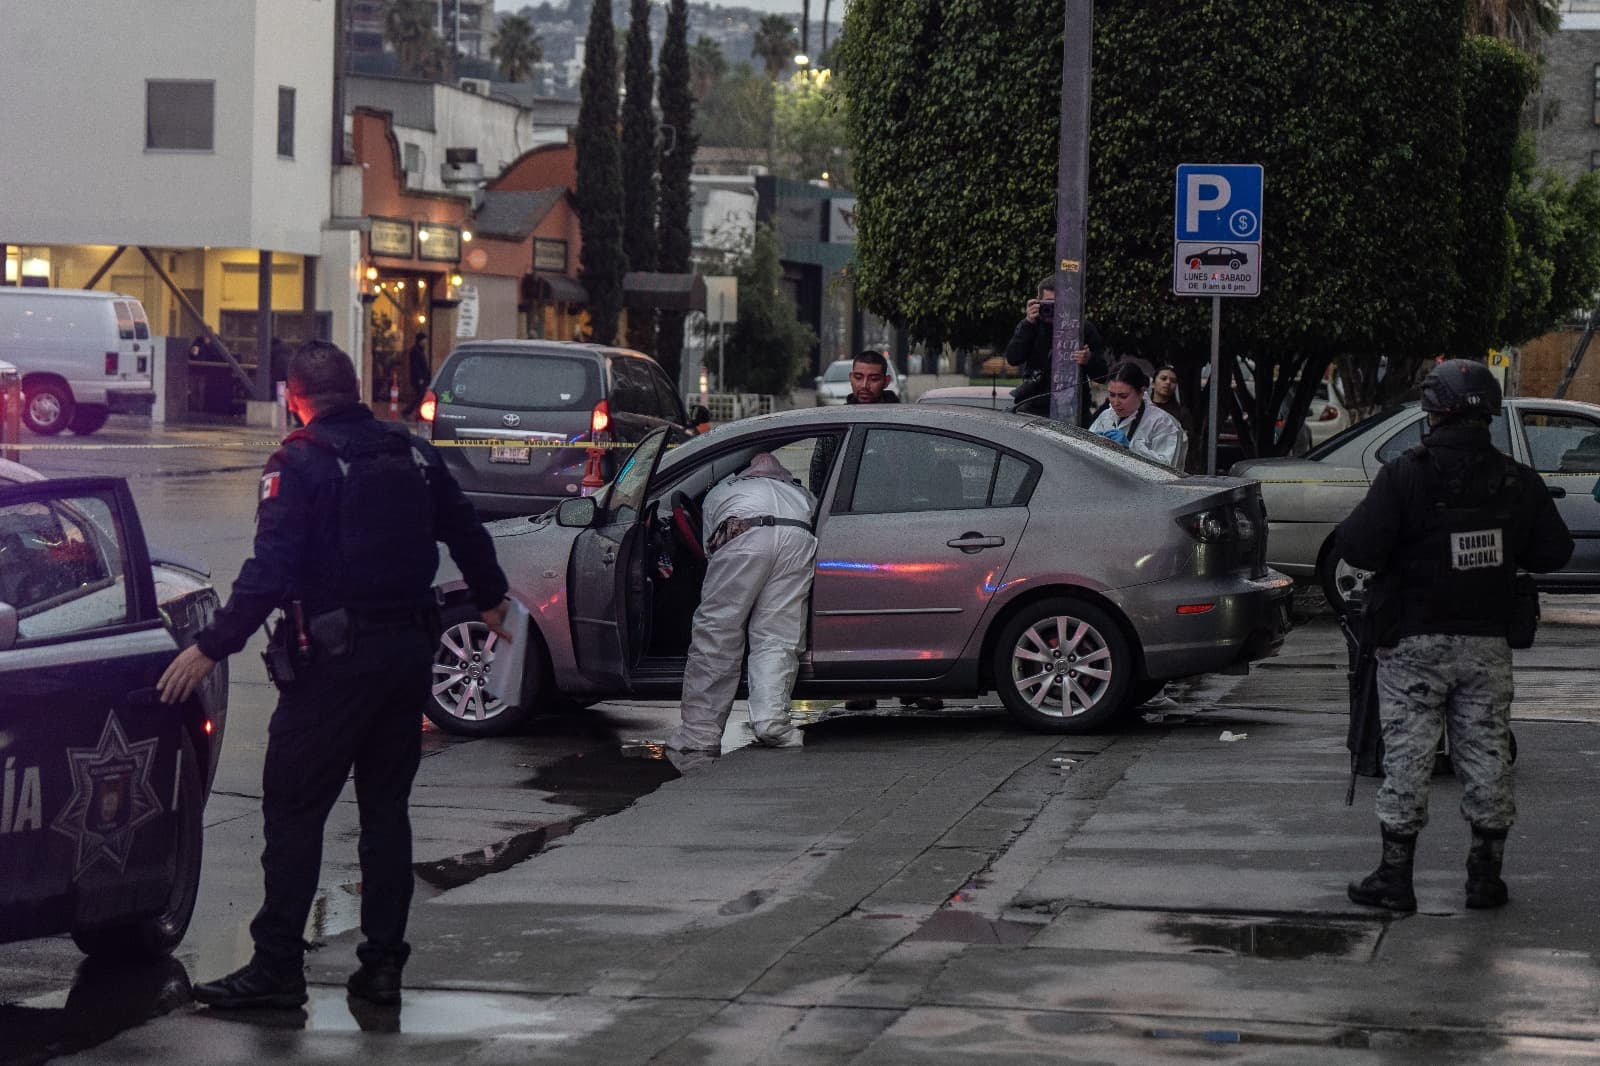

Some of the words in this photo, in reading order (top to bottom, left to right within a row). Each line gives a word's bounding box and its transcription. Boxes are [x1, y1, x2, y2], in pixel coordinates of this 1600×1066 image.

[1186, 174, 1231, 232] P
[1184, 272, 1208, 280] LUNES
[1220, 273, 1251, 282] SABADO
[1459, 533, 1495, 550] GUARDIA
[1458, 549, 1498, 566] NACIONAL
